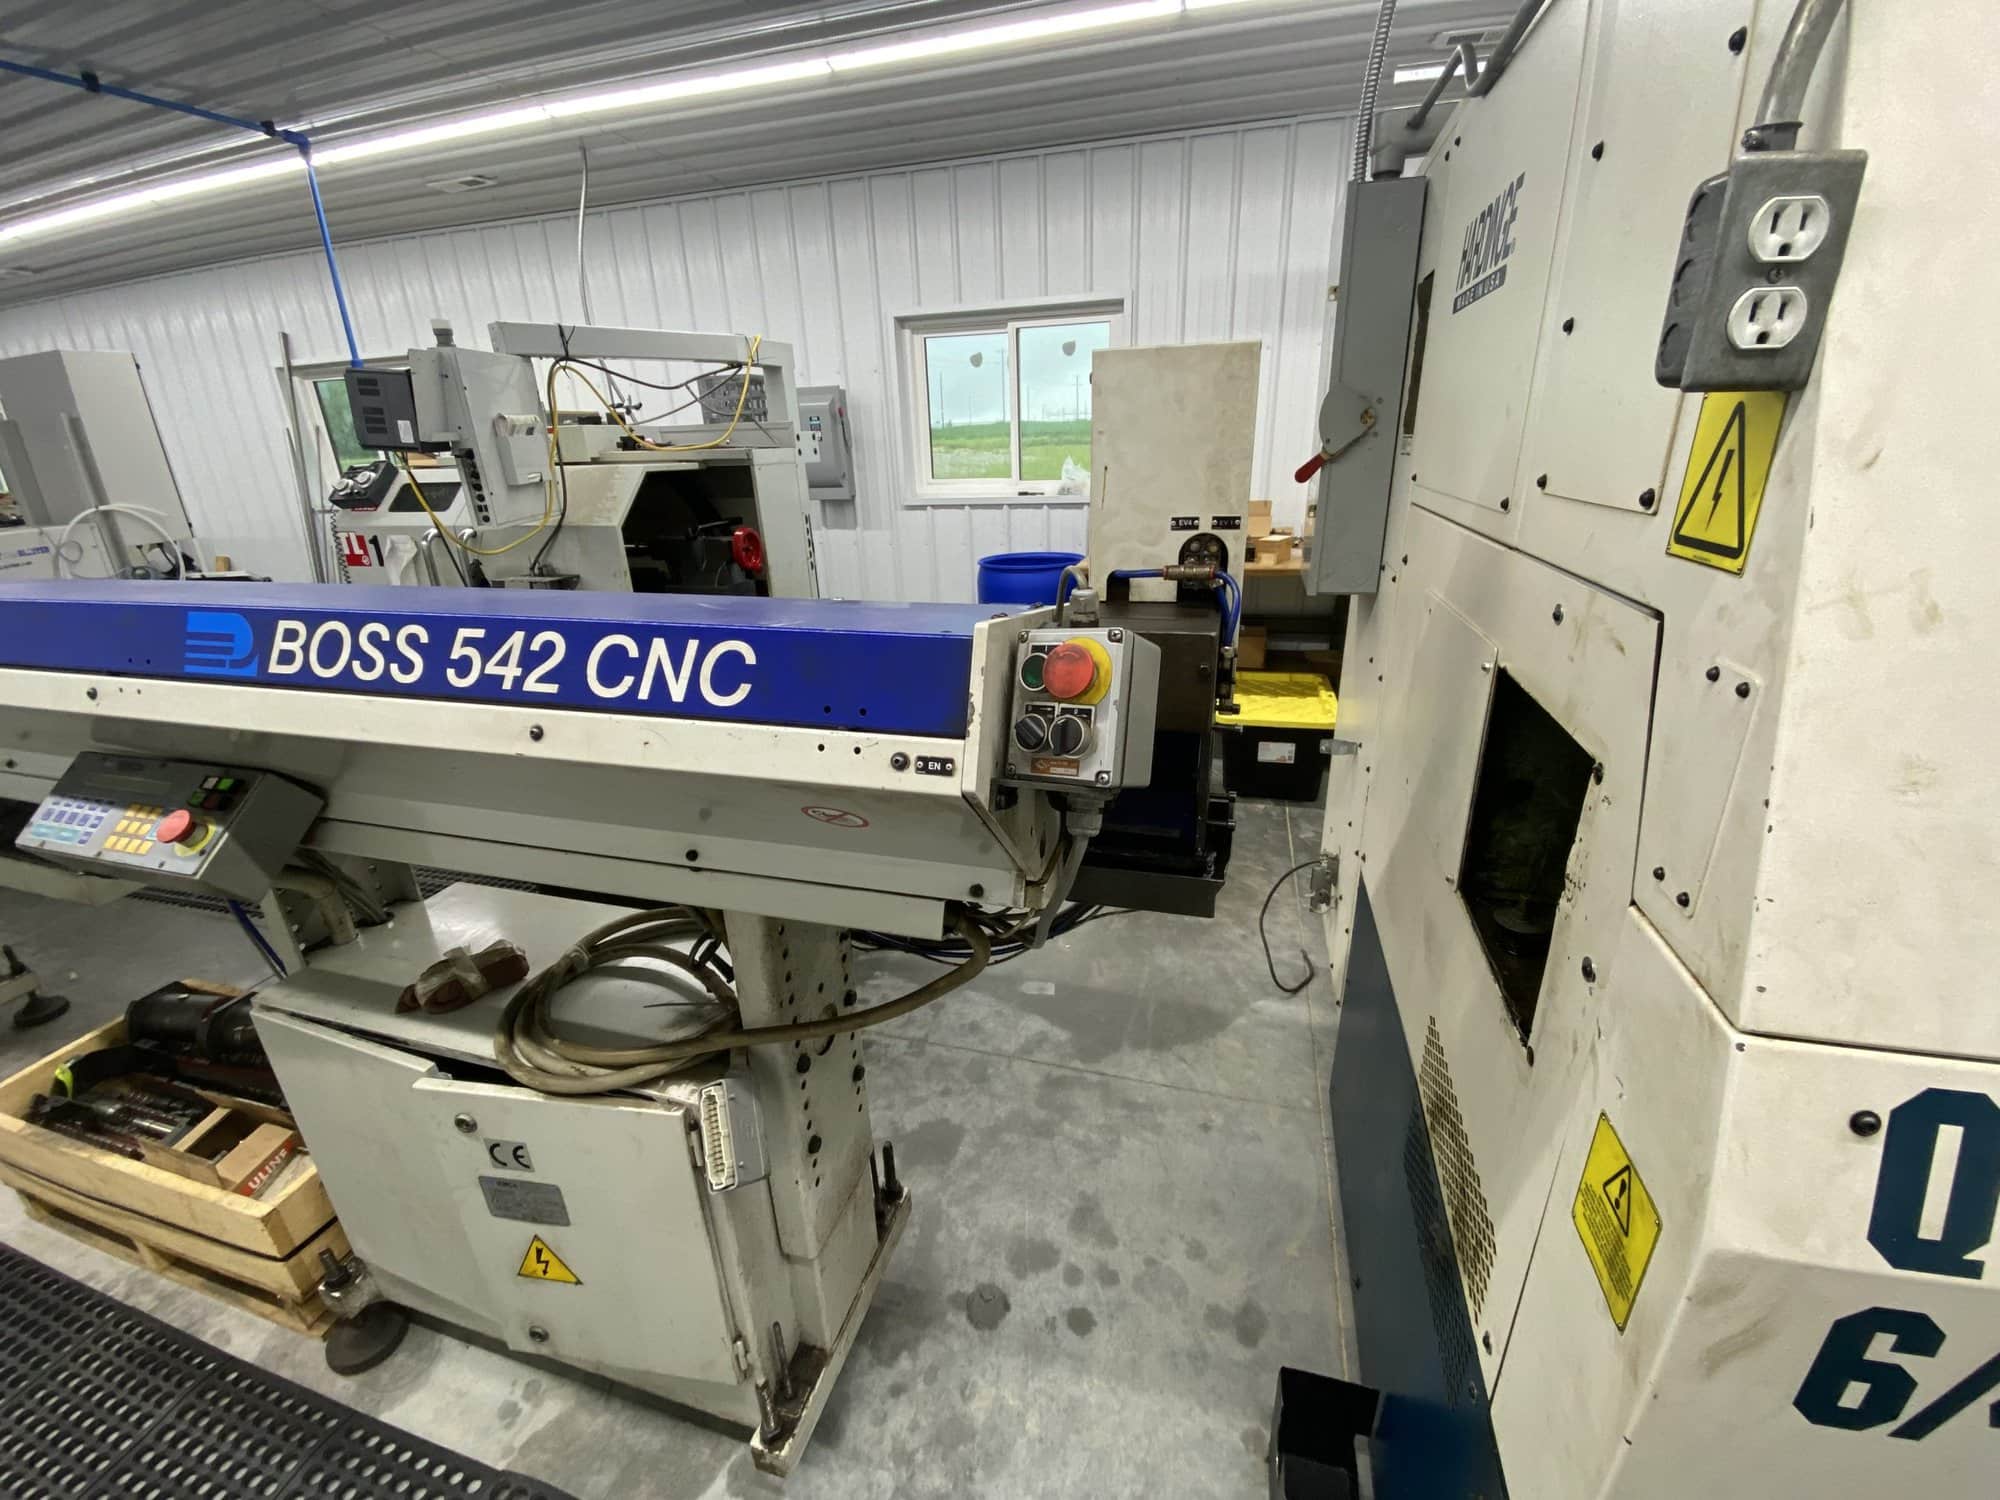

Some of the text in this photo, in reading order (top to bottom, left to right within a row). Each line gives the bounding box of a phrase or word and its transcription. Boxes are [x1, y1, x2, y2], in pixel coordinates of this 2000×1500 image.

[267, 619, 758, 708] BOSS 542 CNC
[928, 761, 941, 770] EN
[1867, 1087, 2000, 1280] Q
[1792, 1306, 2000, 1442] 6/
